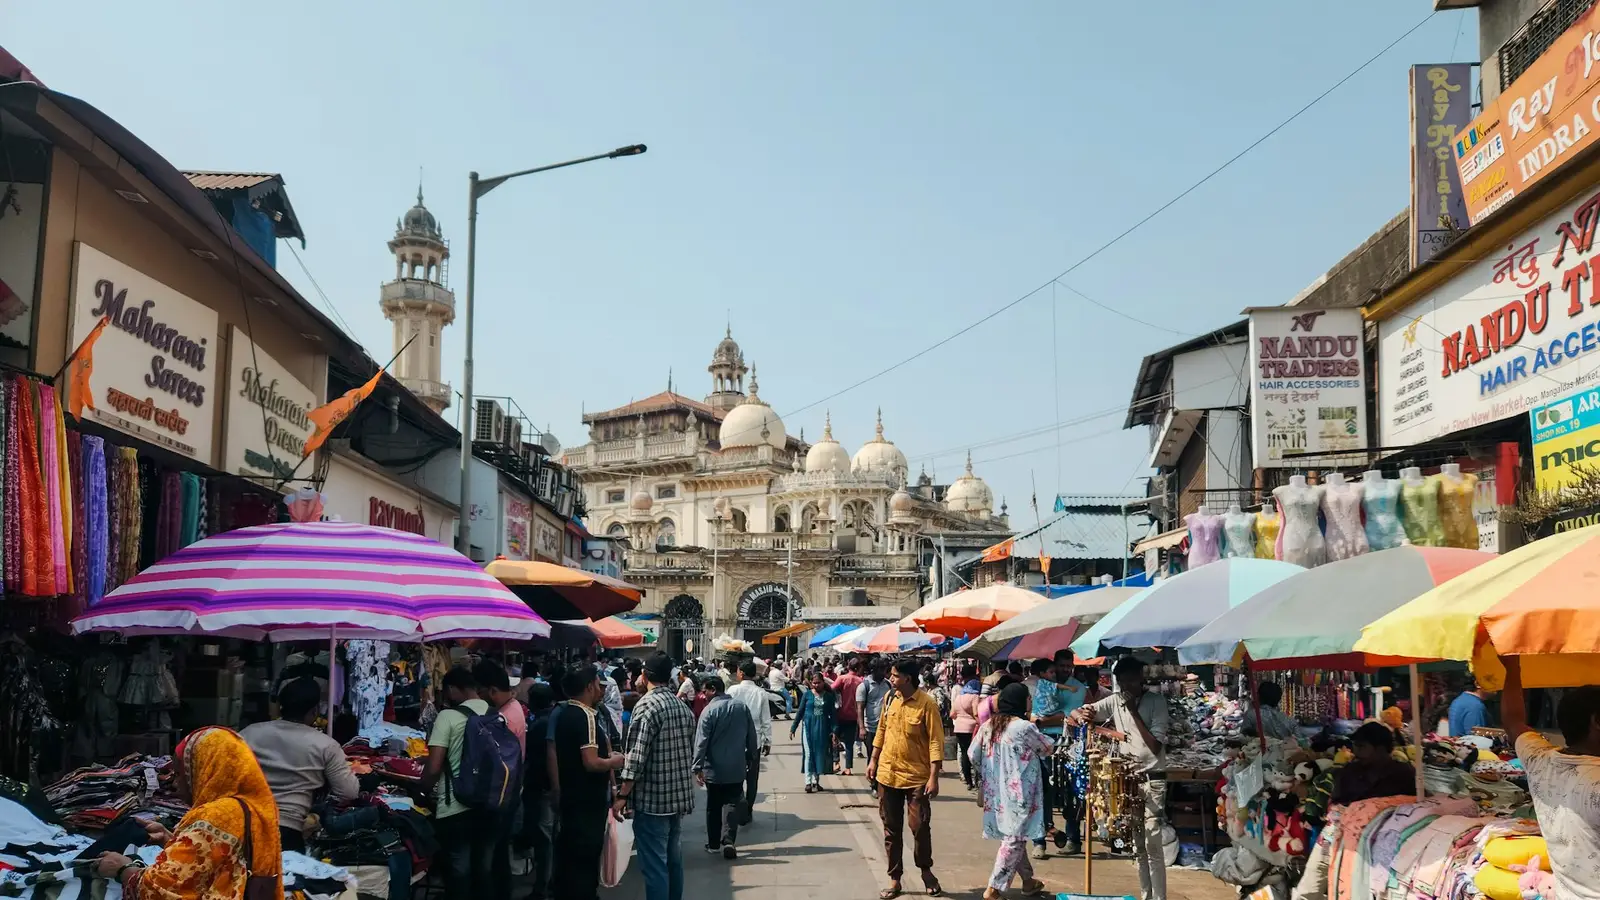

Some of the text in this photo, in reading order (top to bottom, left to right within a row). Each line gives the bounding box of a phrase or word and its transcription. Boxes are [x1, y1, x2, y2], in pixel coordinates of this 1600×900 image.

[1427, 67, 1461, 122] Ray
[1507, 75, 1558, 140] Ray
[1517, 112, 1591, 183] INDRA
[1485, 181, 1508, 202] EYEWEAR
[1492, 237, 1541, 289] नंदु
[91, 279, 206, 371] Maharani
[1260, 335, 1358, 358] NANDU
[1441, 282, 1551, 377] NANDU
[145, 355, 206, 407] Sarees
[1259, 359, 1360, 378] TRADERS
[1480, 319, 1600, 396] HAIR ACCE
[240, 367, 311, 431] Maharani
[1259, 380, 1360, 389] HAIR ACCESSORIES
[265, 416, 306, 459] Dresse
[1470, 410, 1489, 425] New
[1536, 429, 1555, 442] SHOP
[1569, 418, 1581, 430] 19
[370, 496, 425, 537] Raymond
[739, 584, 773, 617] JUMA MASJID
